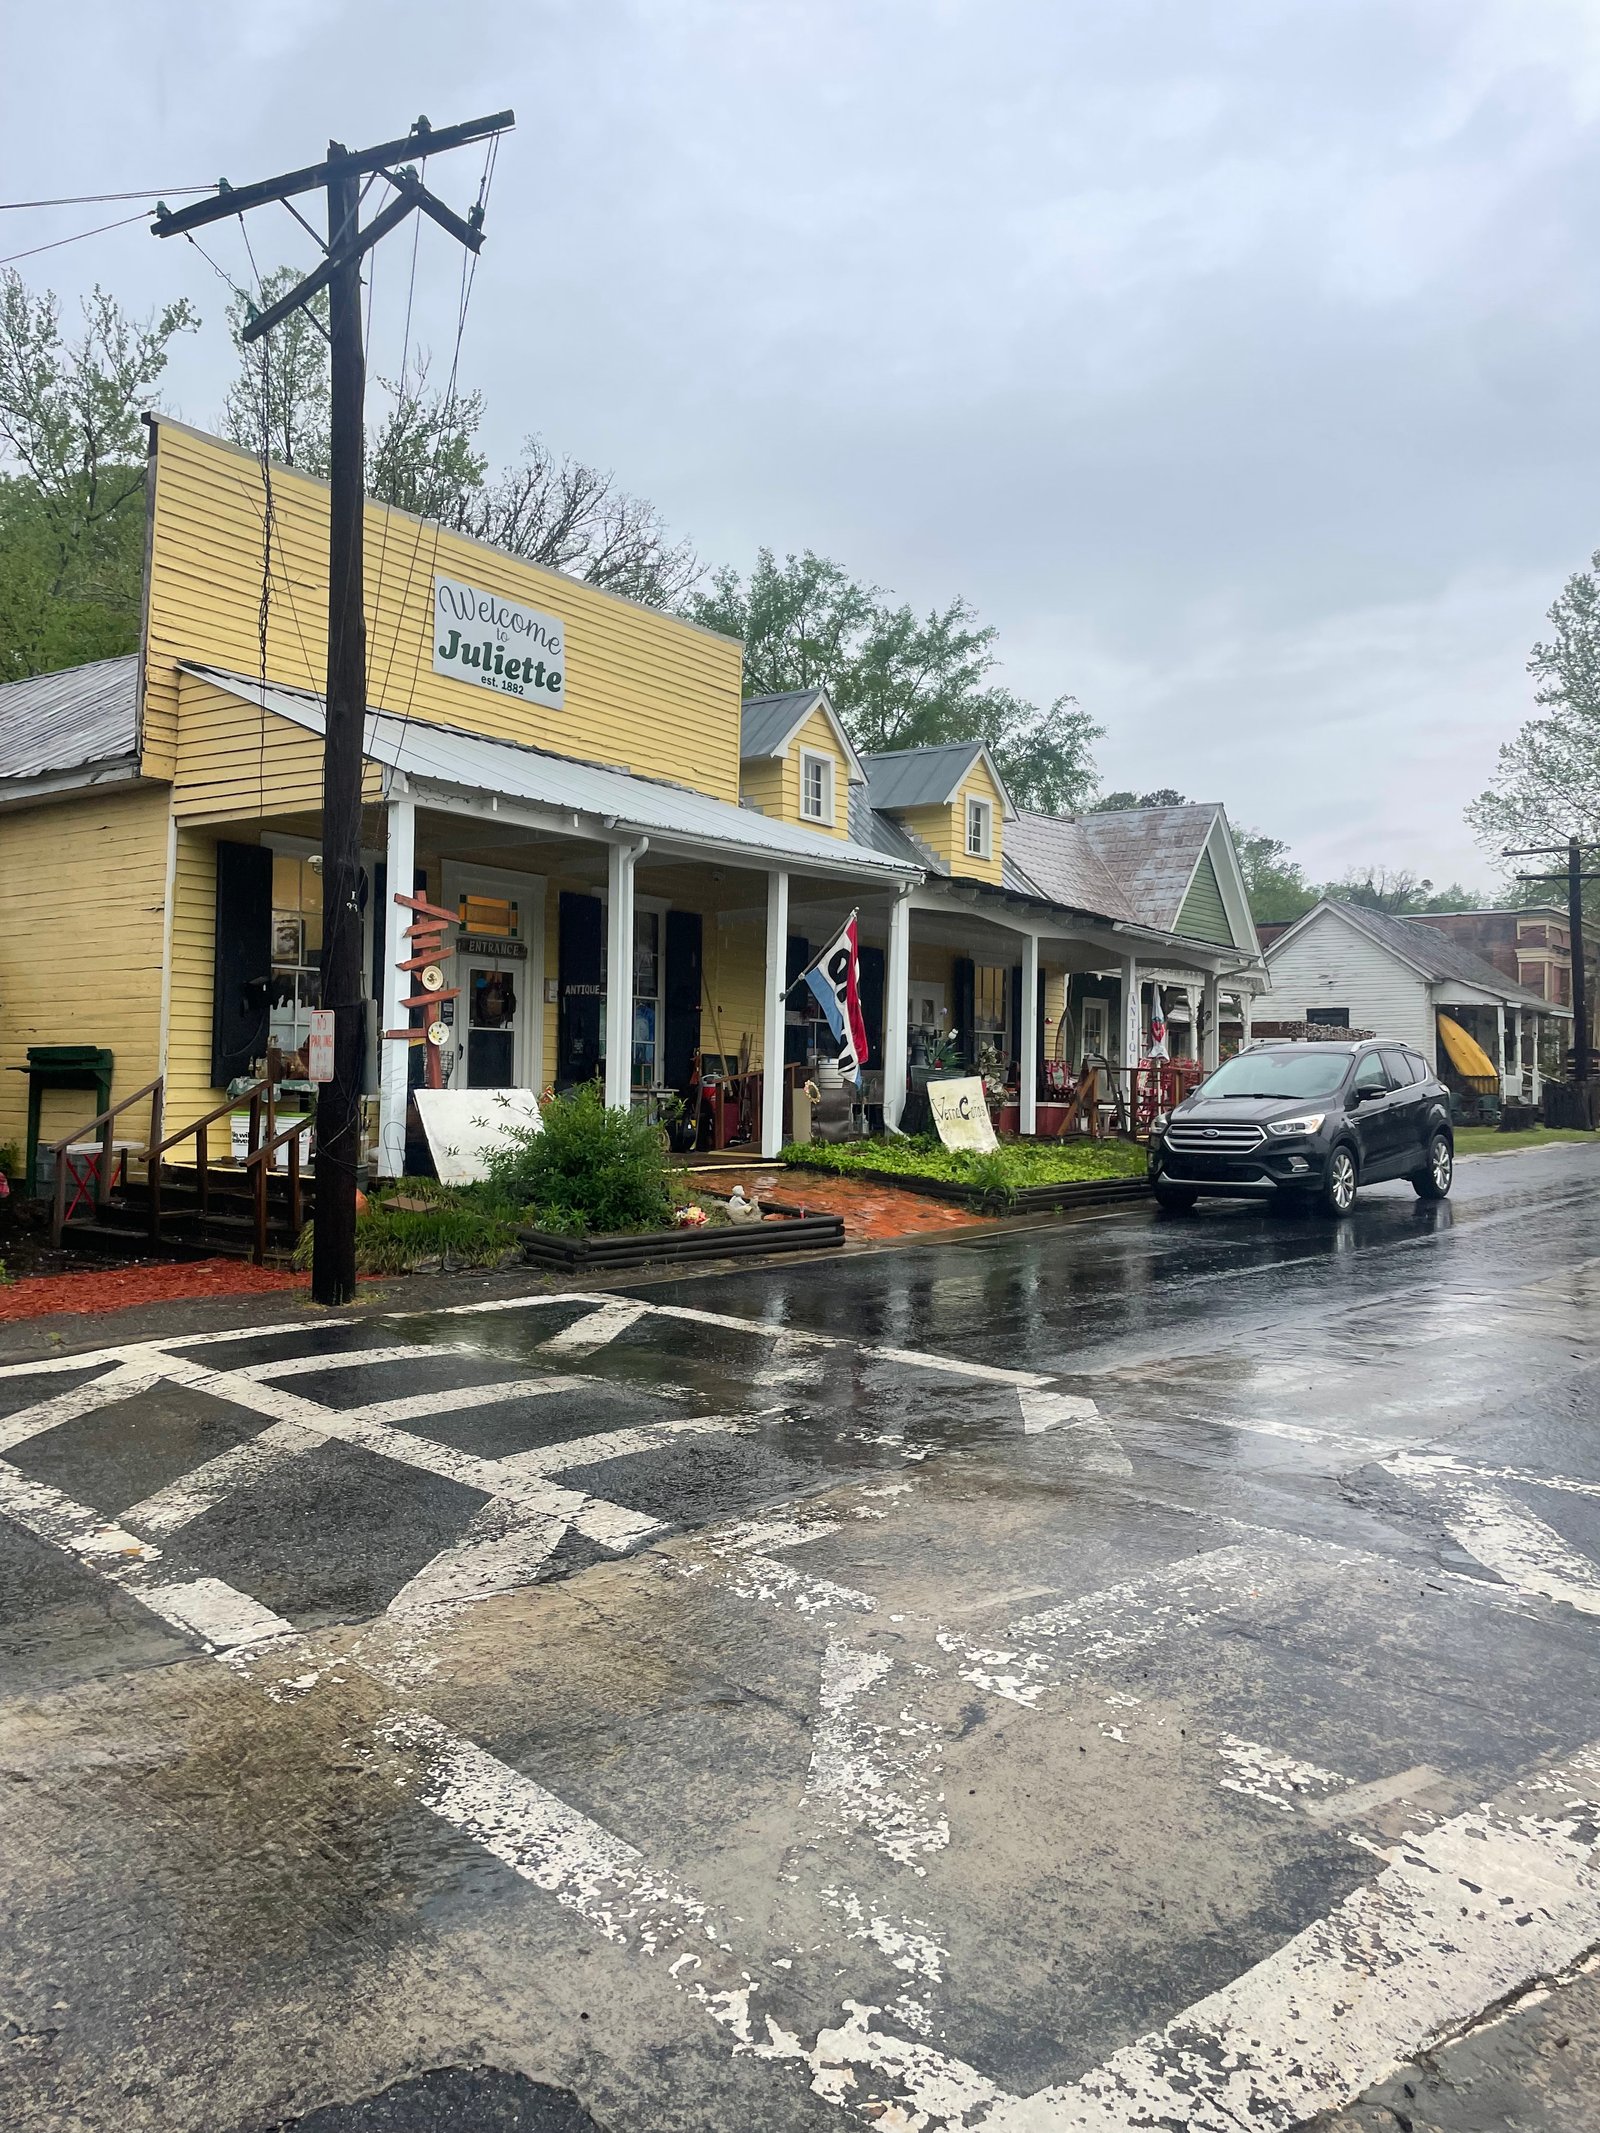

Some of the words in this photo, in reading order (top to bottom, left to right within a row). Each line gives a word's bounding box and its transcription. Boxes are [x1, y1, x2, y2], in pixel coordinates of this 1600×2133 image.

[438, 585, 562, 655] Welcome
[496, 627, 510, 643] to
[438, 629, 562, 693] Juliette
[481, 675, 498, 688] est.
[501, 680, 524, 695] 1882
[468, 940, 519, 956] ENTRANCE
[565, 984, 600, 995] ANTIQUE
